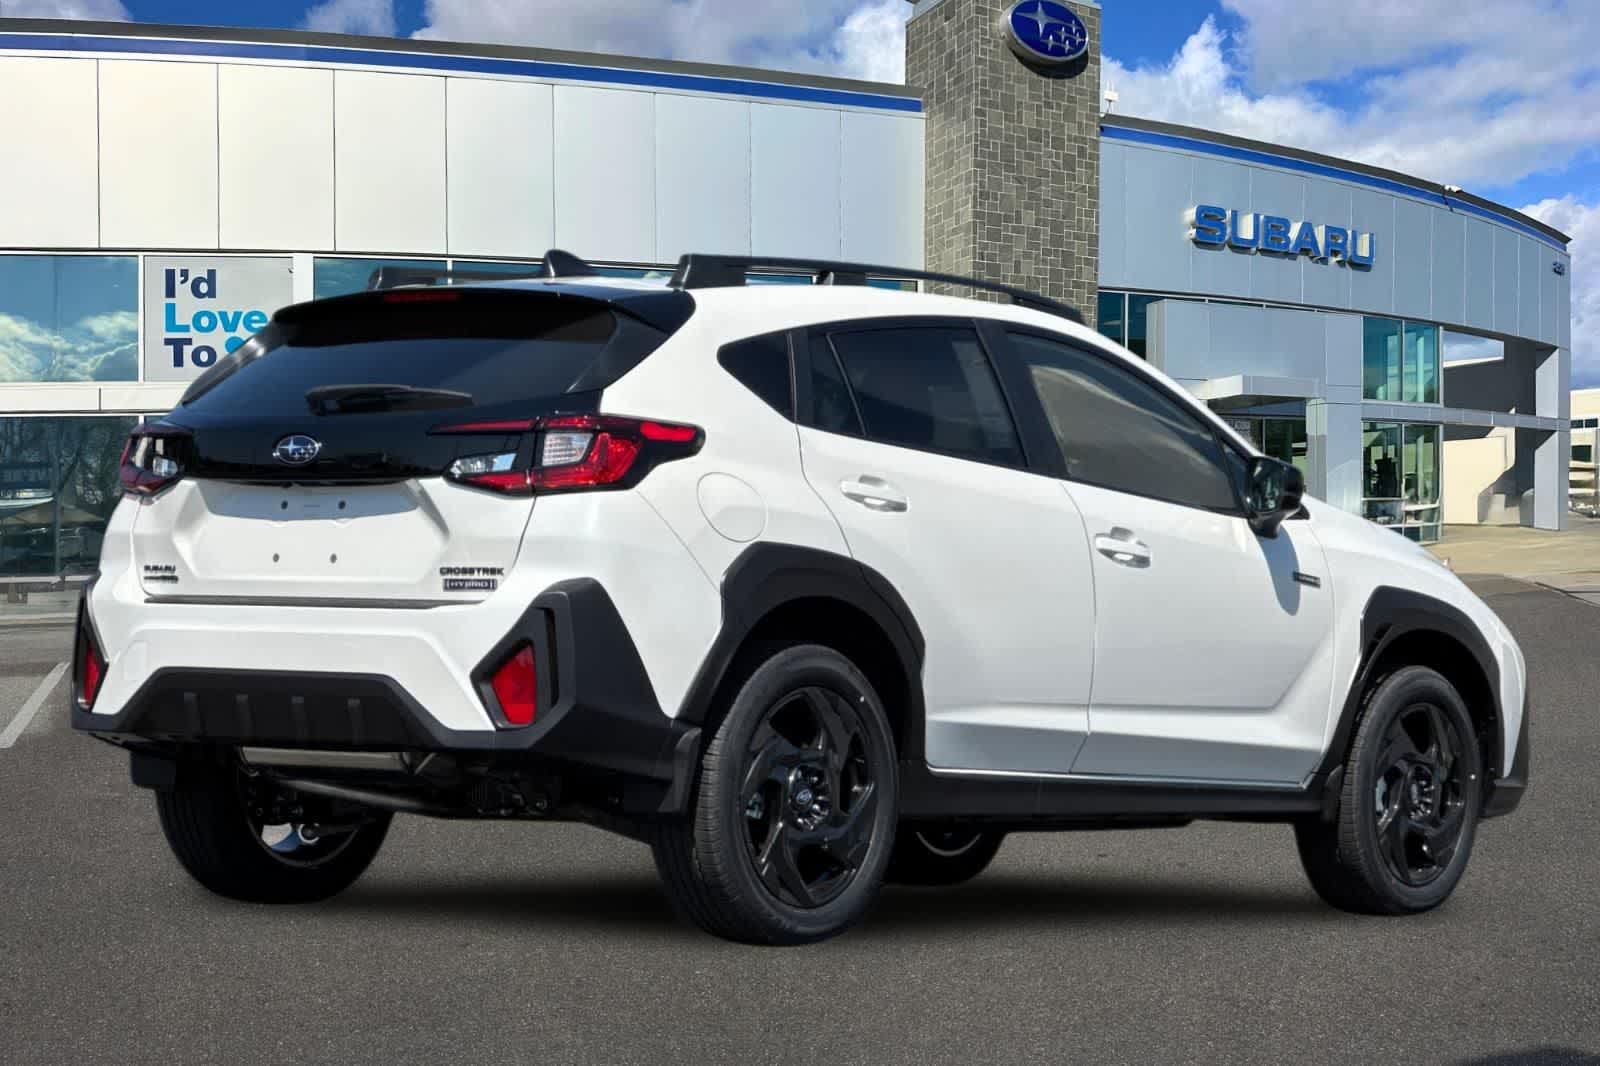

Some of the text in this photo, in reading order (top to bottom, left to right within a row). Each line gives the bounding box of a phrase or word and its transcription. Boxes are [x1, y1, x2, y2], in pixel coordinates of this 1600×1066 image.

[1192, 204, 1376, 267] SUBARU
[164, 268, 217, 299] I'd
[164, 302, 268, 333] Love
[163, 337, 217, 368] To
[439, 566, 505, 577] CROSSTREK
